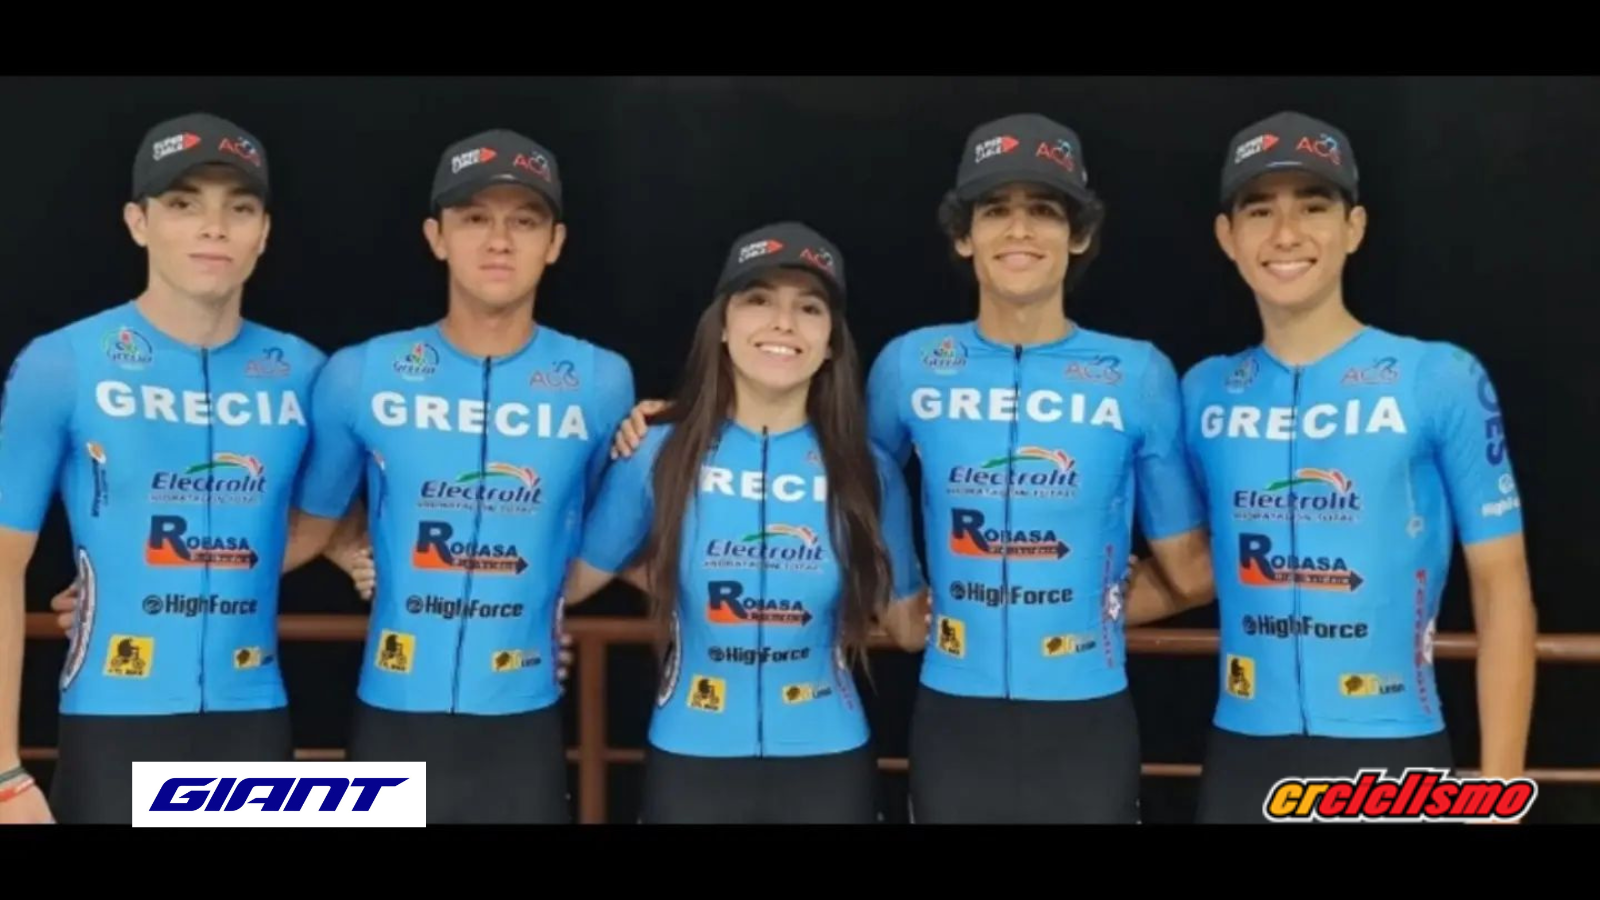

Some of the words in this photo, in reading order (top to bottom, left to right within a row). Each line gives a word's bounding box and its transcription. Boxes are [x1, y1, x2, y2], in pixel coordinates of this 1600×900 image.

[95, 380, 306, 426] GRECIA
[911, 387, 1125, 432] GRECIA
[371, 391, 589, 441] GRECIA
[1201, 396, 1407, 441] GRECIA
[151, 471, 267, 493] Electrolit
[701, 465, 829, 502] RECI
[948, 465, 1081, 487] Electrolit
[420, 479, 542, 504] Electrolit
[1233, 489, 1361, 511] Electrolit
[705, 538, 824, 561] Electrolit
[165, 594, 258, 617] HighForce
[1257, 614, 1369, 639] HighForce
[726, 646, 811, 666] HigForce
